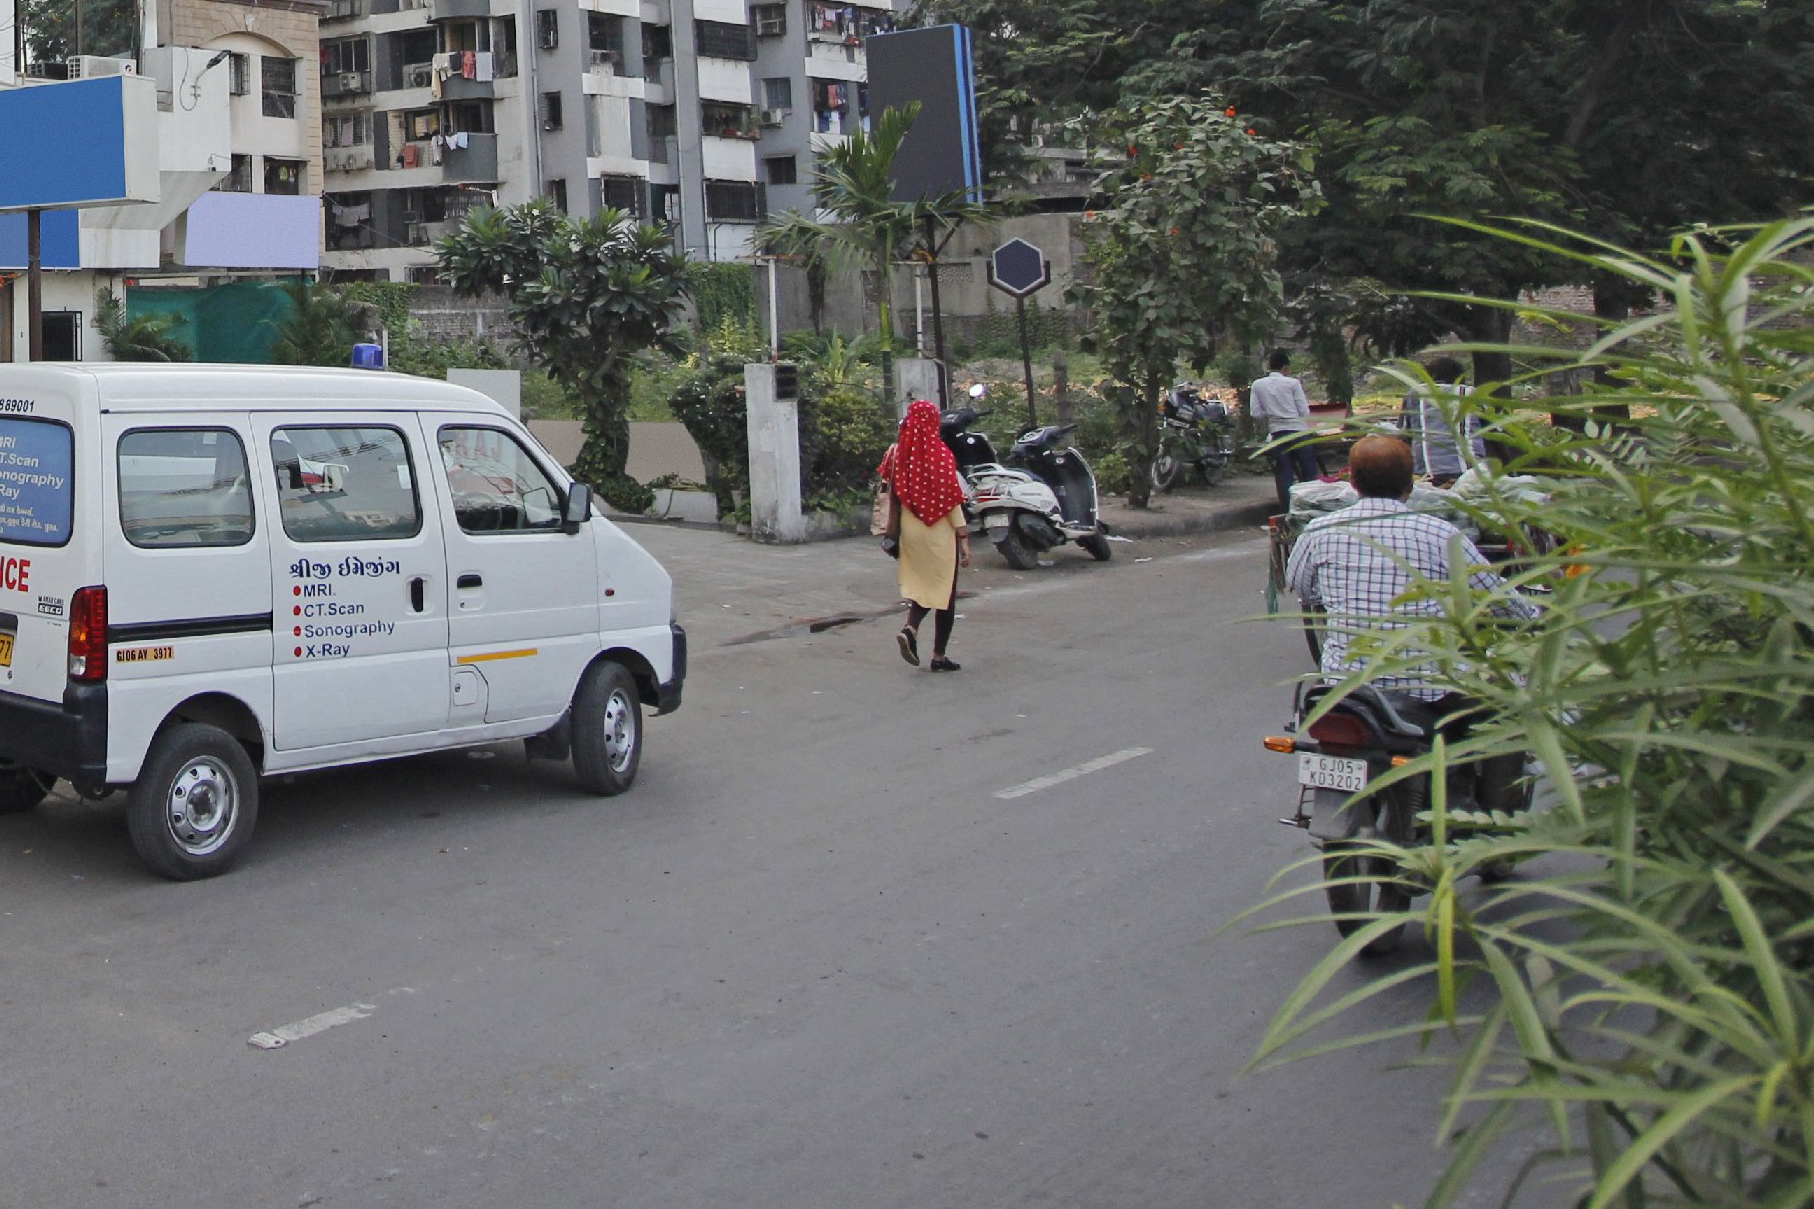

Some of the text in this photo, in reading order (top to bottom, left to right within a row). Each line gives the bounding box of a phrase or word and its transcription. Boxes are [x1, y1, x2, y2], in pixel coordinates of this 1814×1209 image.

[304, 619, 395, 639] Sonography
[306, 643, 350, 658] X-Ray
[1319, 758, 1354, 774] GJ05
